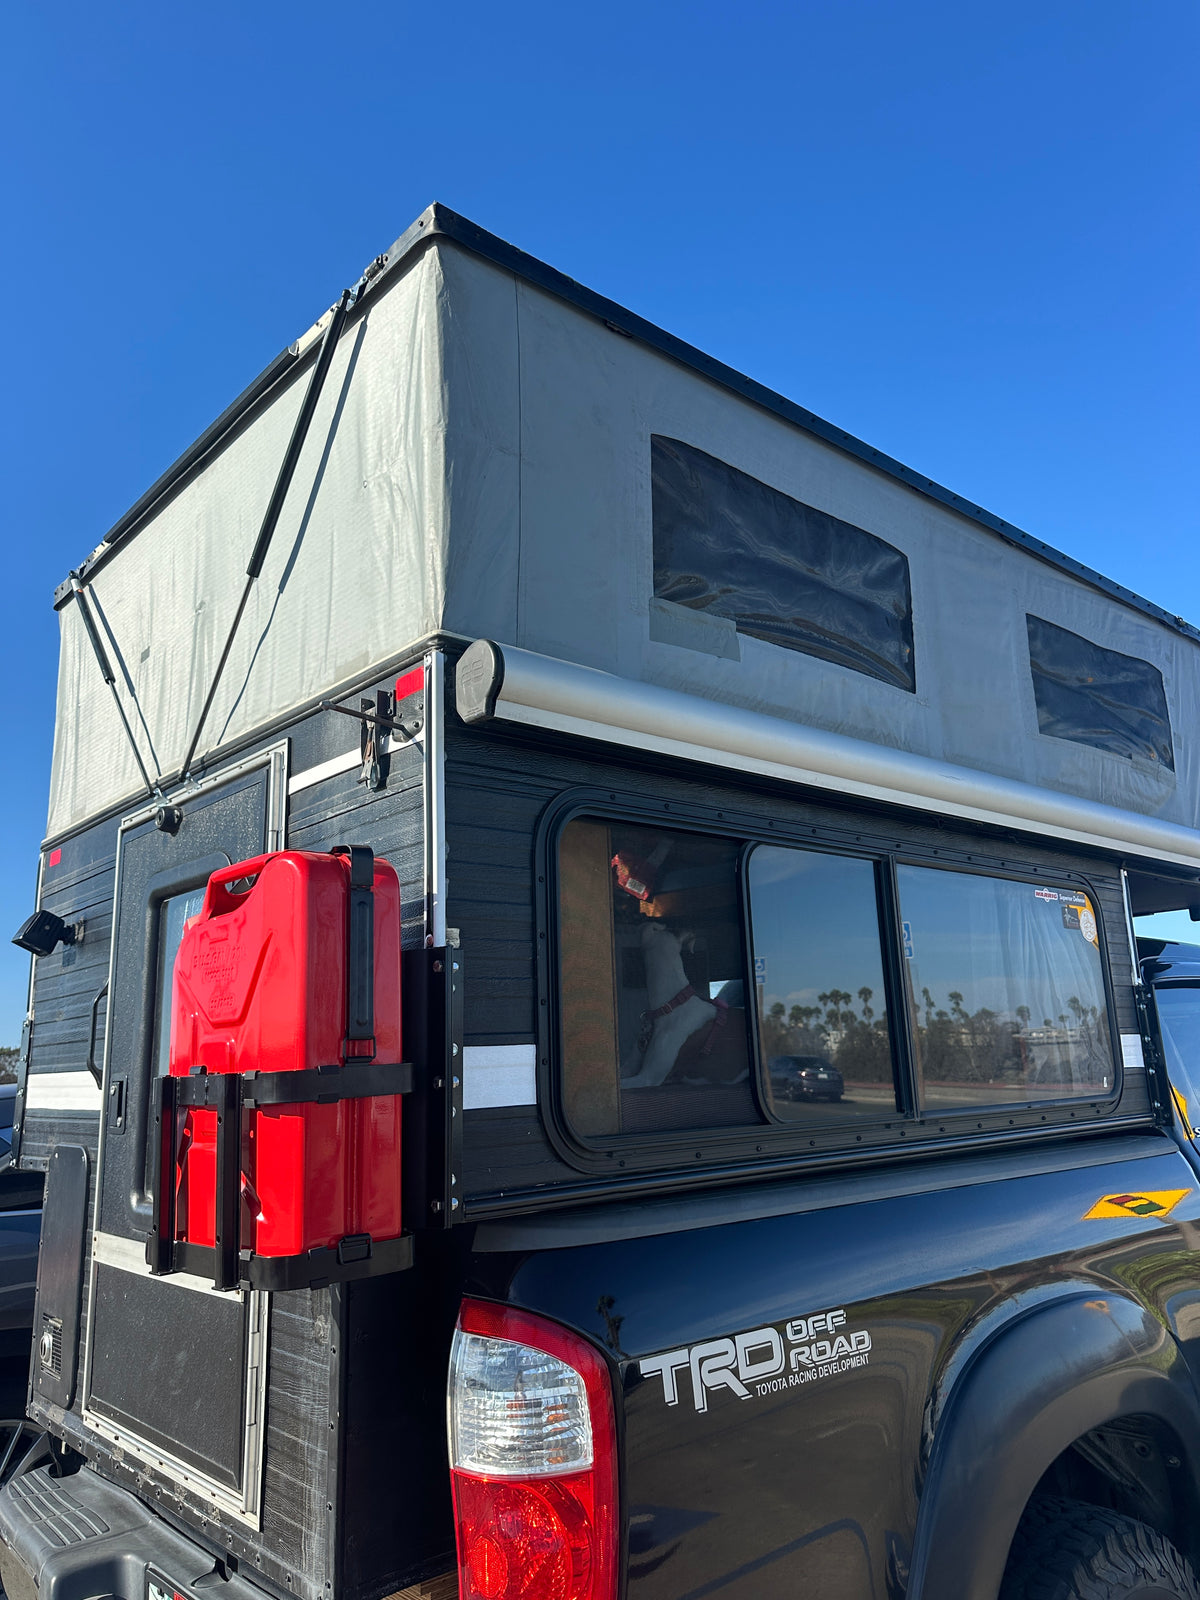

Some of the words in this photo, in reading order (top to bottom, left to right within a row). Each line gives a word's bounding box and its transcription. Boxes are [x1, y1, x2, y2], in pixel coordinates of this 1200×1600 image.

[786, 1309, 847, 1344] OFF
[639, 1327, 786, 1414] TRD
[789, 1330, 872, 1372] ROAD
[755, 1377, 788, 1397] TOYOTA
[788, 1368, 818, 1387] RACING
[818, 1353, 870, 1378] DEVELOPMENT
